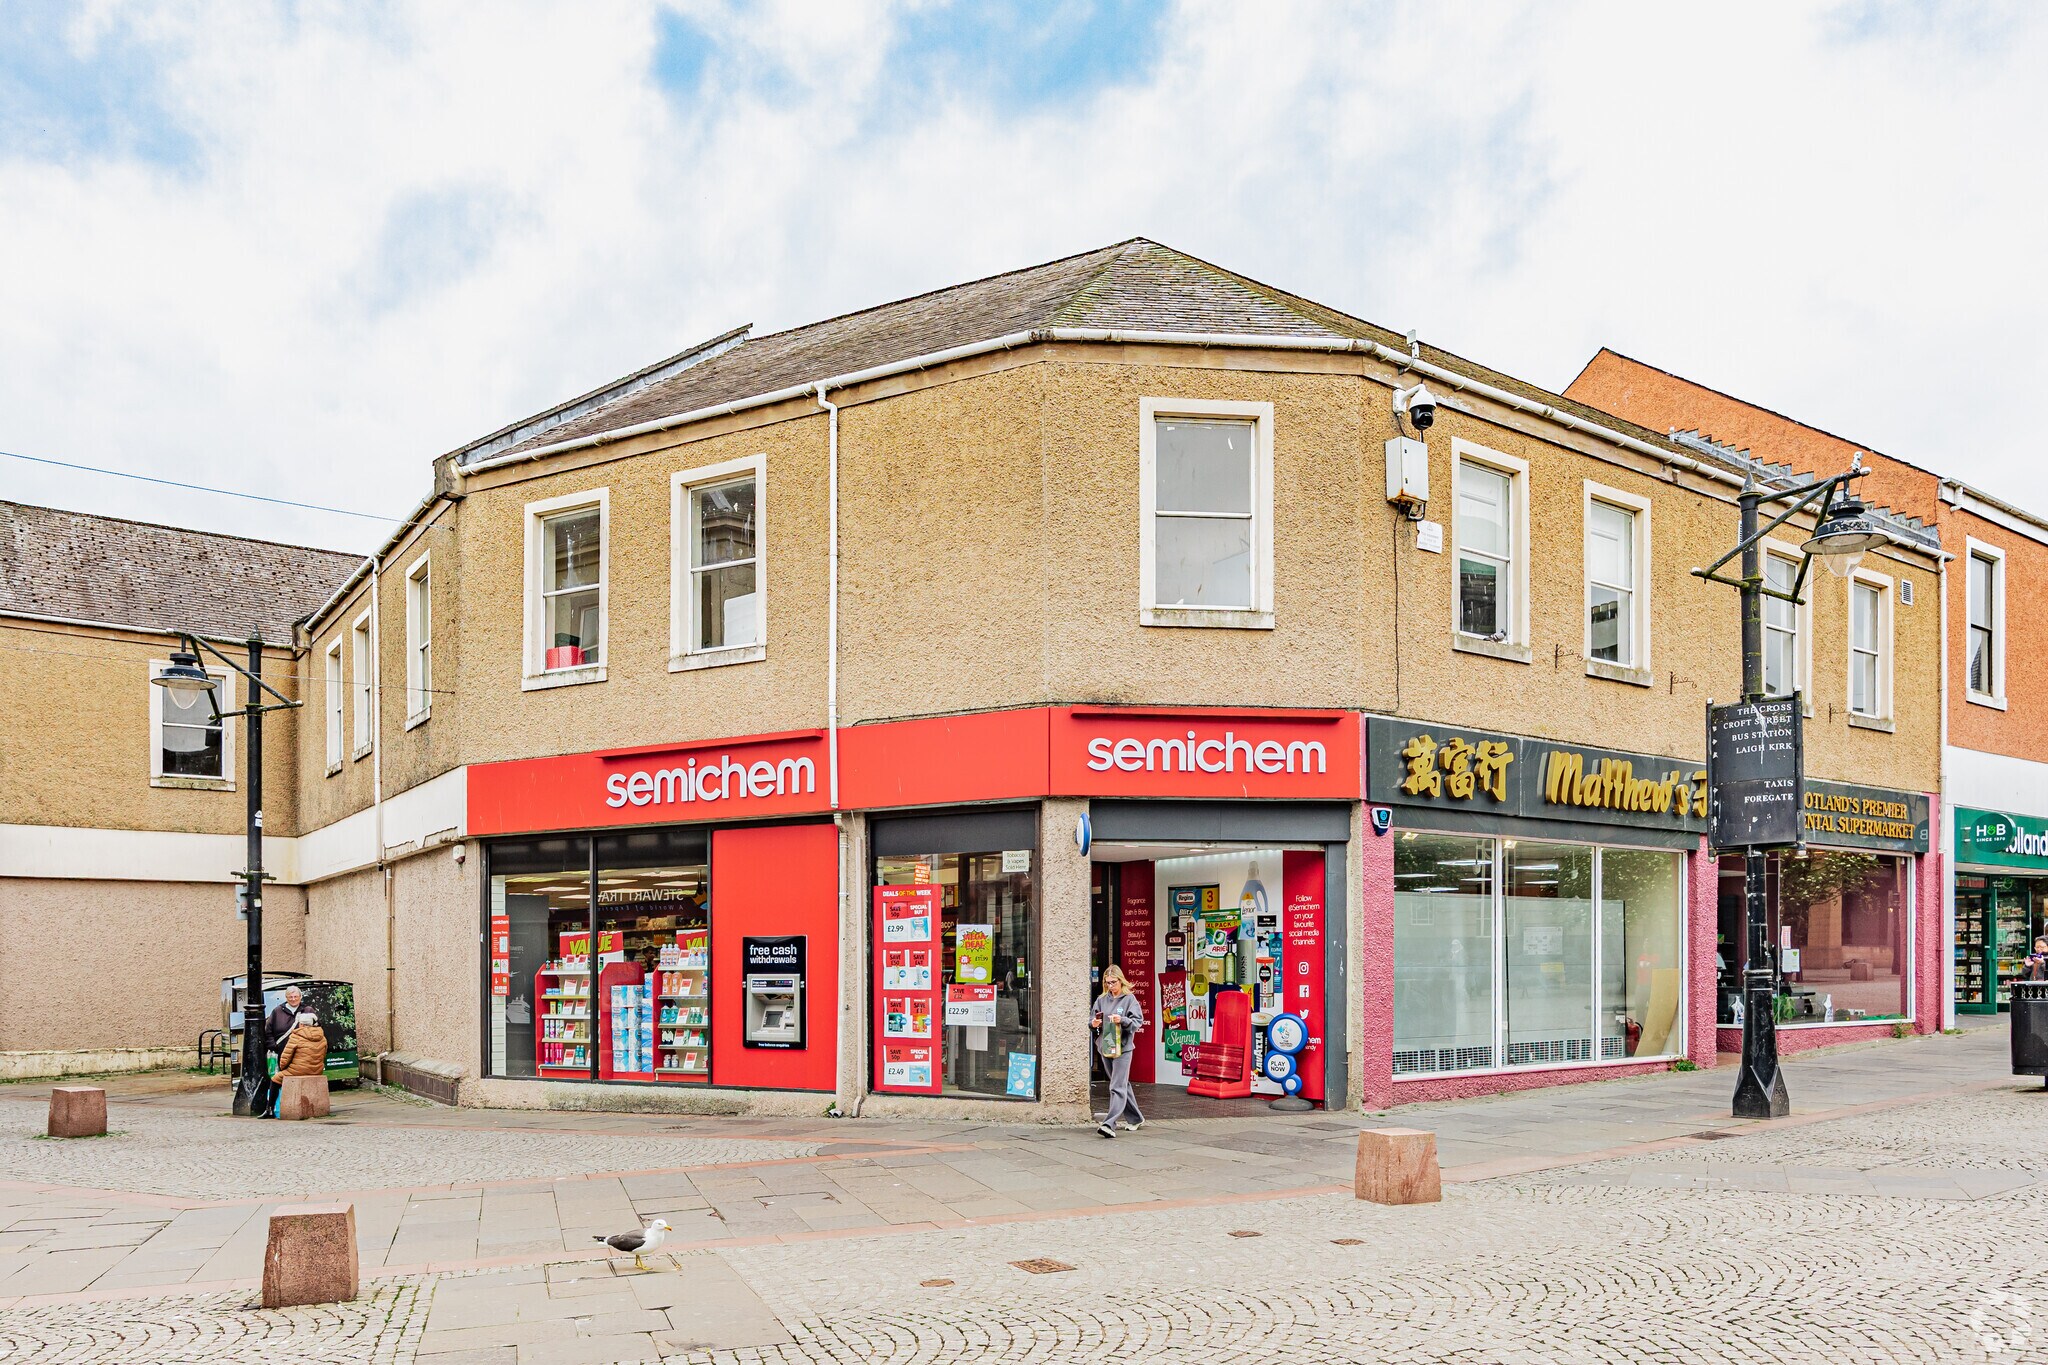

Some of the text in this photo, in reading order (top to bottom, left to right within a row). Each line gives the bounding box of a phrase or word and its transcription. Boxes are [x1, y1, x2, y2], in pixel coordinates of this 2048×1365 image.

[1737, 703, 1792, 716] THE CROSS
[1723, 715, 1792, 730] CROFT STREET
[1732, 729, 1792, 742] BUS STATION
[1087, 730, 1327, 774] semichem
[1736, 742, 1792, 755] LAIGH KIRK
[606, 755, 815, 808] semichem
[1546, 750, 1690, 816] Matthew's
[1764, 779, 1794, 788] TAXIS
[1744, 793, 1794, 804] FOREGATE
[1804, 791, 1908, 819] OTLAND'S PREMIER
[1805, 812, 1915, 839] NTAL SUPERMARKET
[1976, 823, 2006, 836] H&B
[1206, 890, 1214, 903] 3
[1127, 898, 1146, 906] Fragrance
[1242, 906, 1256, 915] Lenor
[1288, 903, 1320, 912] @Semichem
[1138, 909, 1148, 917] Body
[887, 925, 904, 933] £2.99
[1289, 929, 1302, 937] social
[963, 931, 987, 940] MEGA
[1127, 931, 1140, 939] Beauty
[965, 941, 985, 949] DEAL
[1292, 937, 1316, 945] channels
[749, 943, 797, 955] free cash
[1137, 949, 1150, 957] Décor
[749, 955, 797, 964] withdrawals
[948, 1007, 969, 1015] £22.99
[1166, 1031, 1198, 1046] Skinny
[1254, 1031, 1263, 1073] LAVAZZA
[888, 1068, 904, 1076] £2.49
